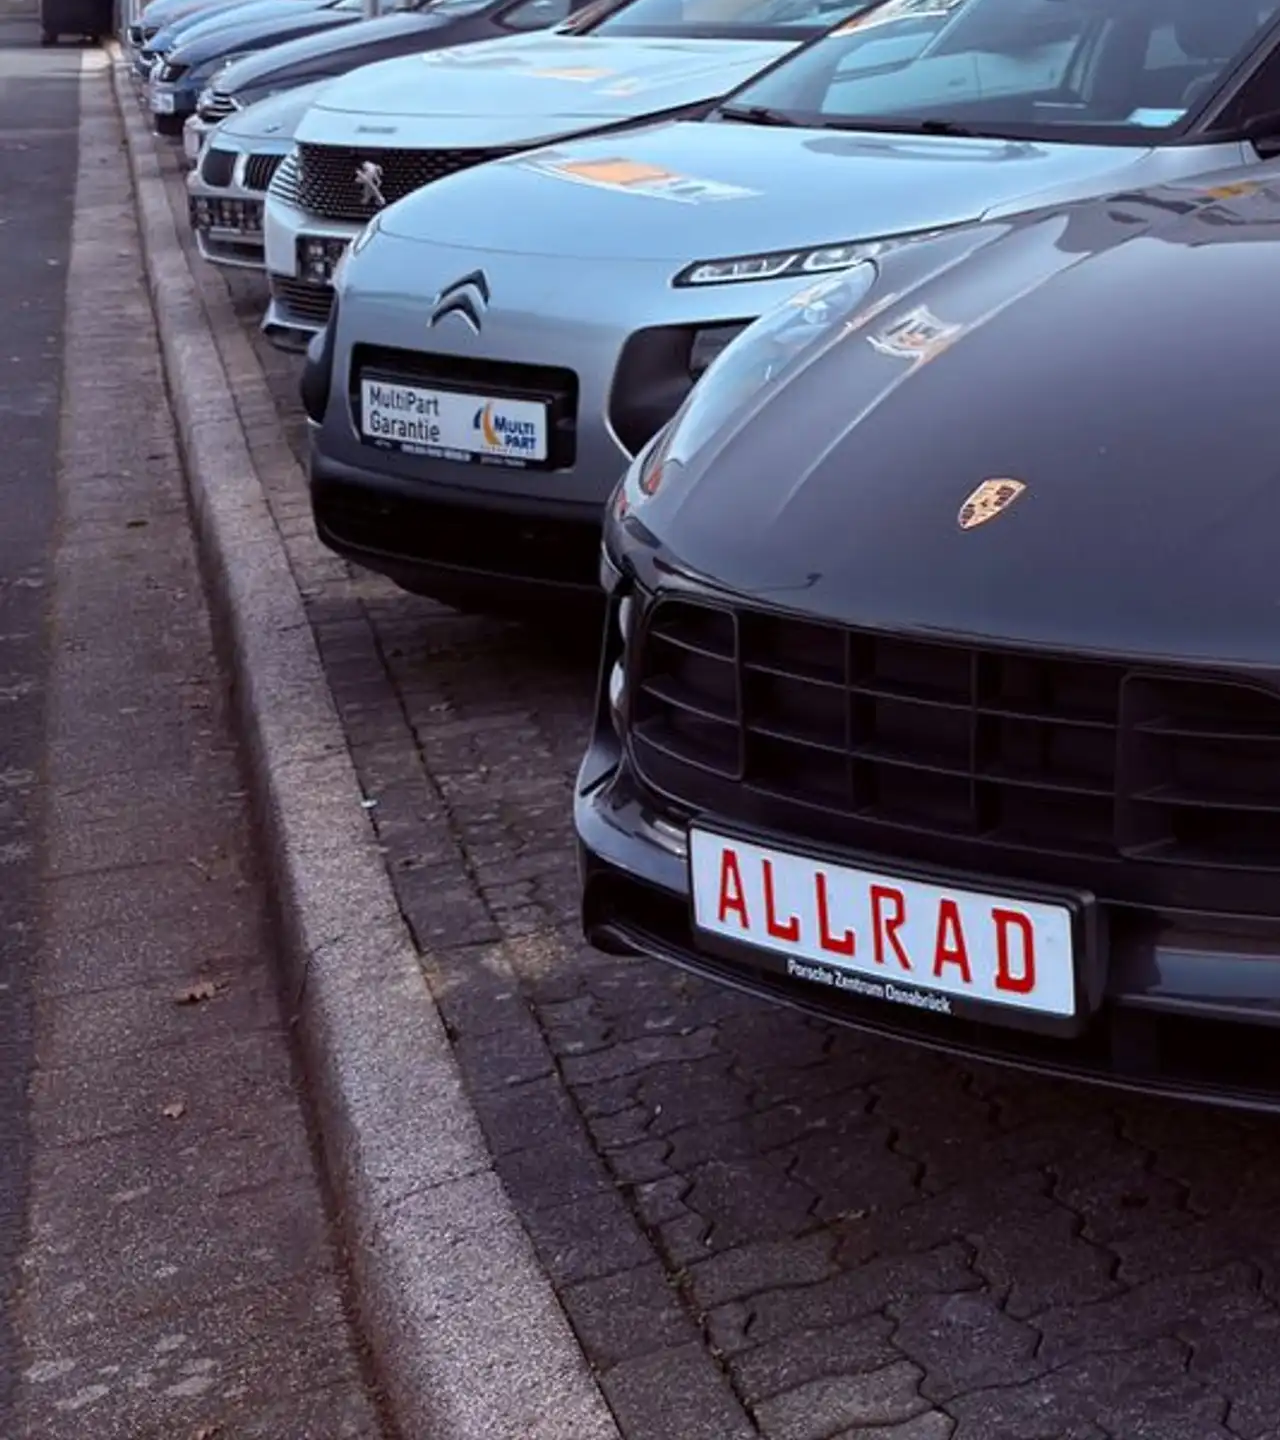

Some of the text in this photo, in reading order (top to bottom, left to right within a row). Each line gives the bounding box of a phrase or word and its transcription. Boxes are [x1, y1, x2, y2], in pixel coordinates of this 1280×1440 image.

[369, 386, 440, 417] MultiPart
[369, 410, 441, 443] Garantie
[504, 433, 538, 451] PART
[717, 847, 1037, 996] ALLRAD
[787, 958, 952, 1014] Porsche Zentrum Osnabrück
